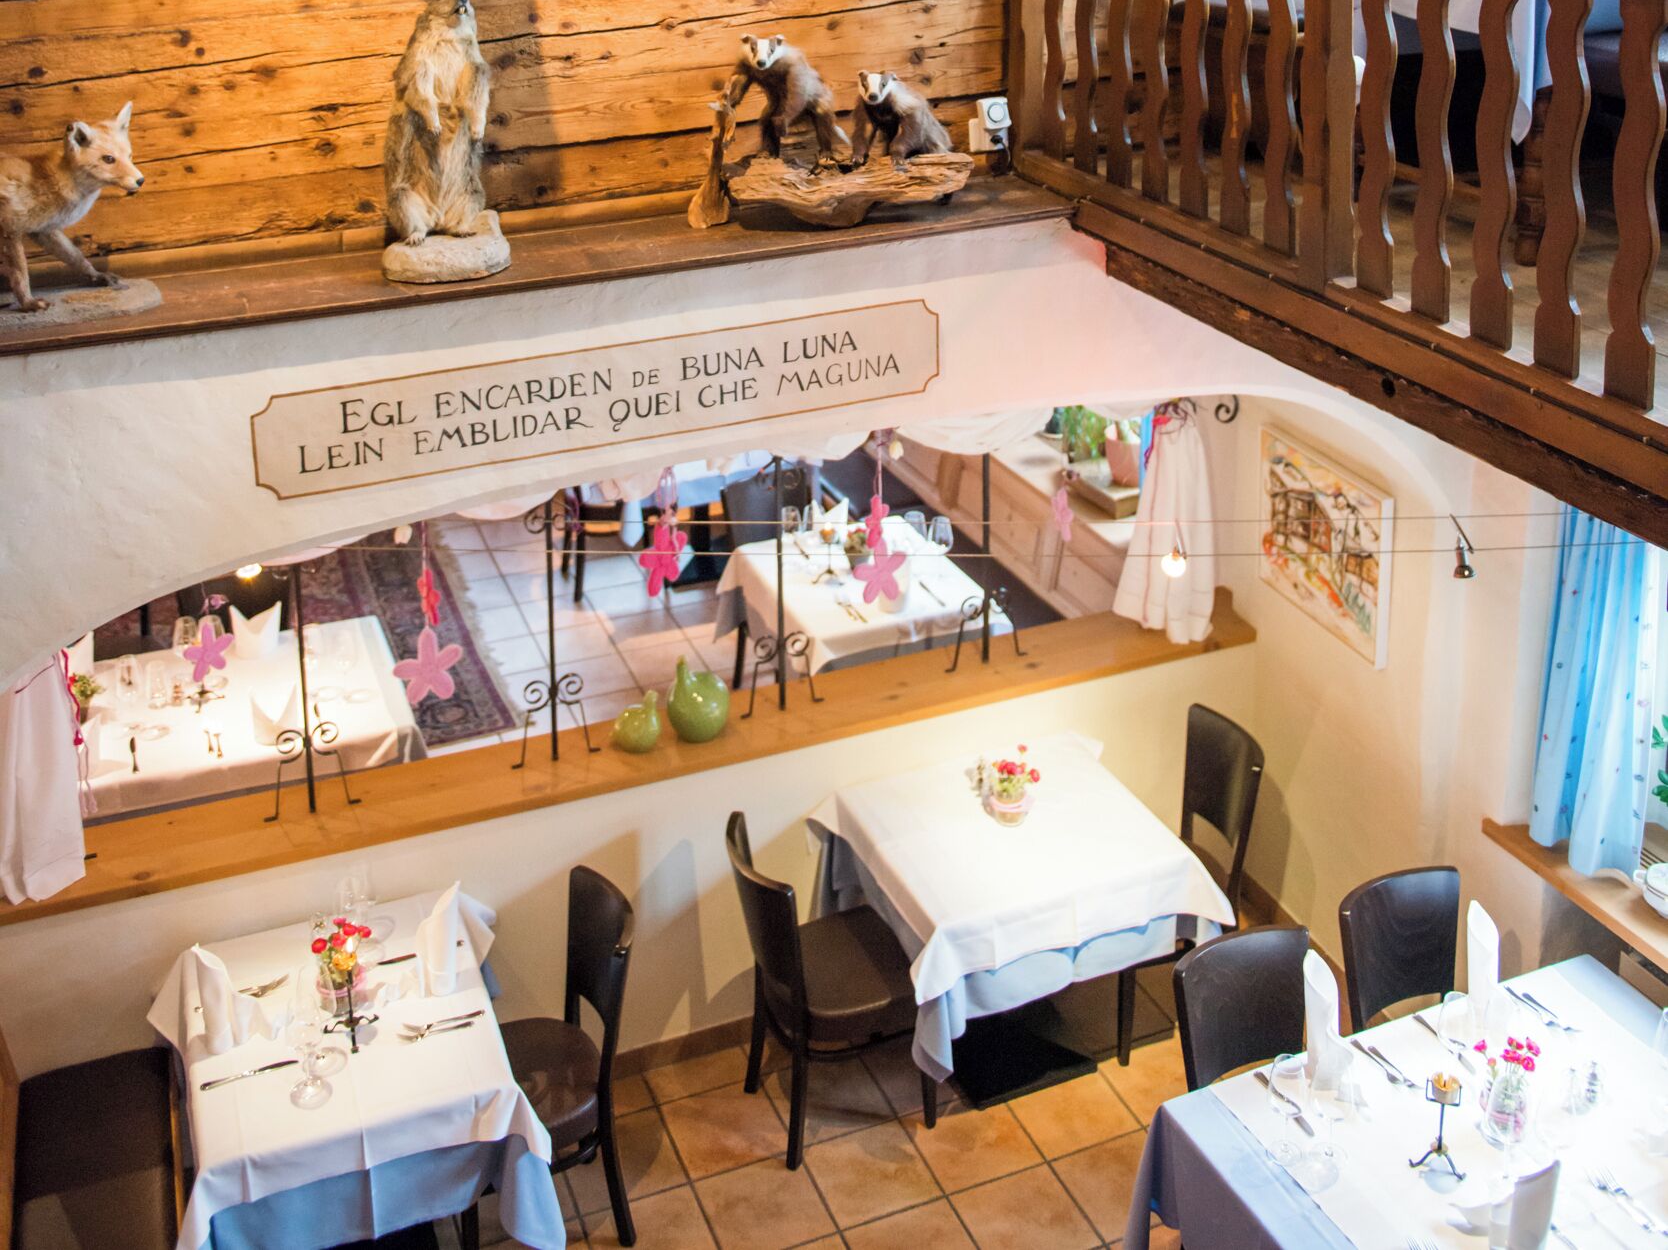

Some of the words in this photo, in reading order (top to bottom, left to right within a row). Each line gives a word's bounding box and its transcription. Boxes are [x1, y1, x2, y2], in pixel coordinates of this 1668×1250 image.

[298, 438, 383, 474] LEIN
[413, 406, 594, 455] EMBLIDAR
[608, 390, 681, 432] QUEI
[697, 377, 759, 409] CHE
[776, 353, 900, 396] MAGUNA
[340, 398, 417, 434] EGL
[434, 368, 612, 418] ENCARDEN
[680, 347, 764, 381] BUNA
[783, 330, 858, 364] LUNA
